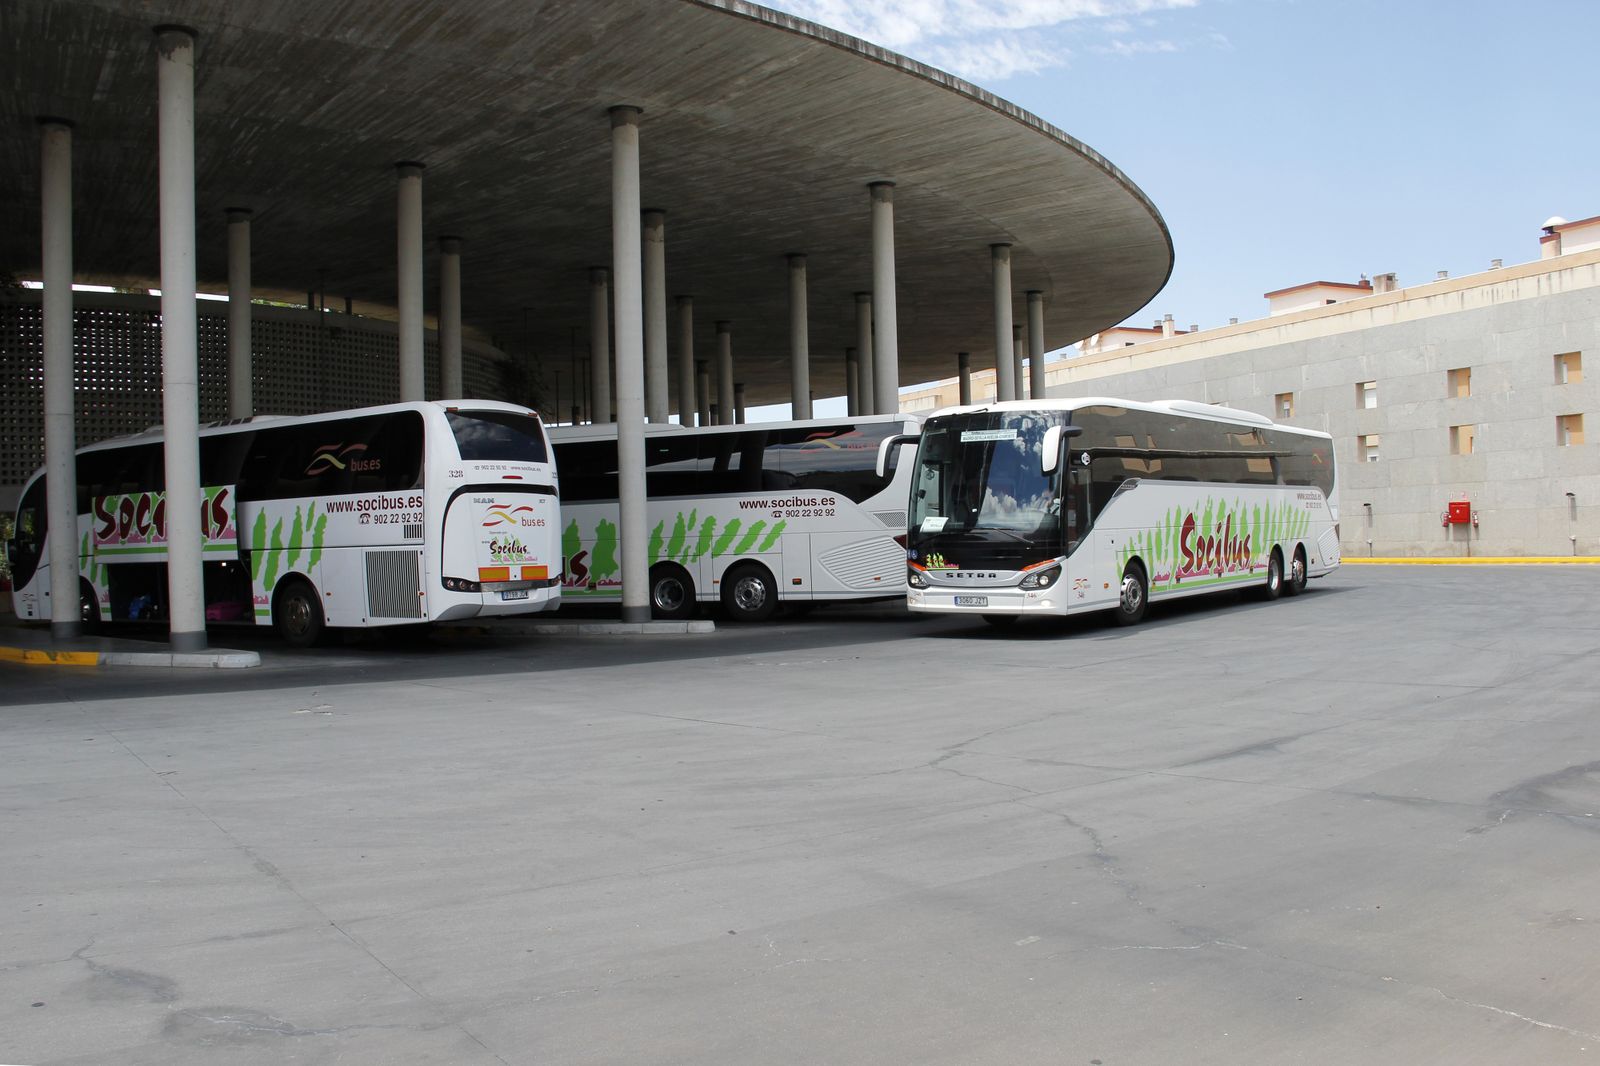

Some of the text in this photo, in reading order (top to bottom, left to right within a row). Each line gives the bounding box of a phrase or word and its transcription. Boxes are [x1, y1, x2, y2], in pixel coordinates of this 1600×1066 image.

[350, 458, 381, 471] bus.es
[448, 470, 464, 478] 328
[326, 495, 423, 513] www.socibus.es
[739, 496, 836, 509] www.socibus.es
[374, 512, 423, 524] 902 22 92 92
[802, 509, 812, 517] 22
[813, 509, 823, 517] 92
[825, 508, 835, 516] 92
[521, 516, 545, 527] bus.es
[490, 540, 527, 554] Socibus
[1180, 512, 1251, 574] Socibus
